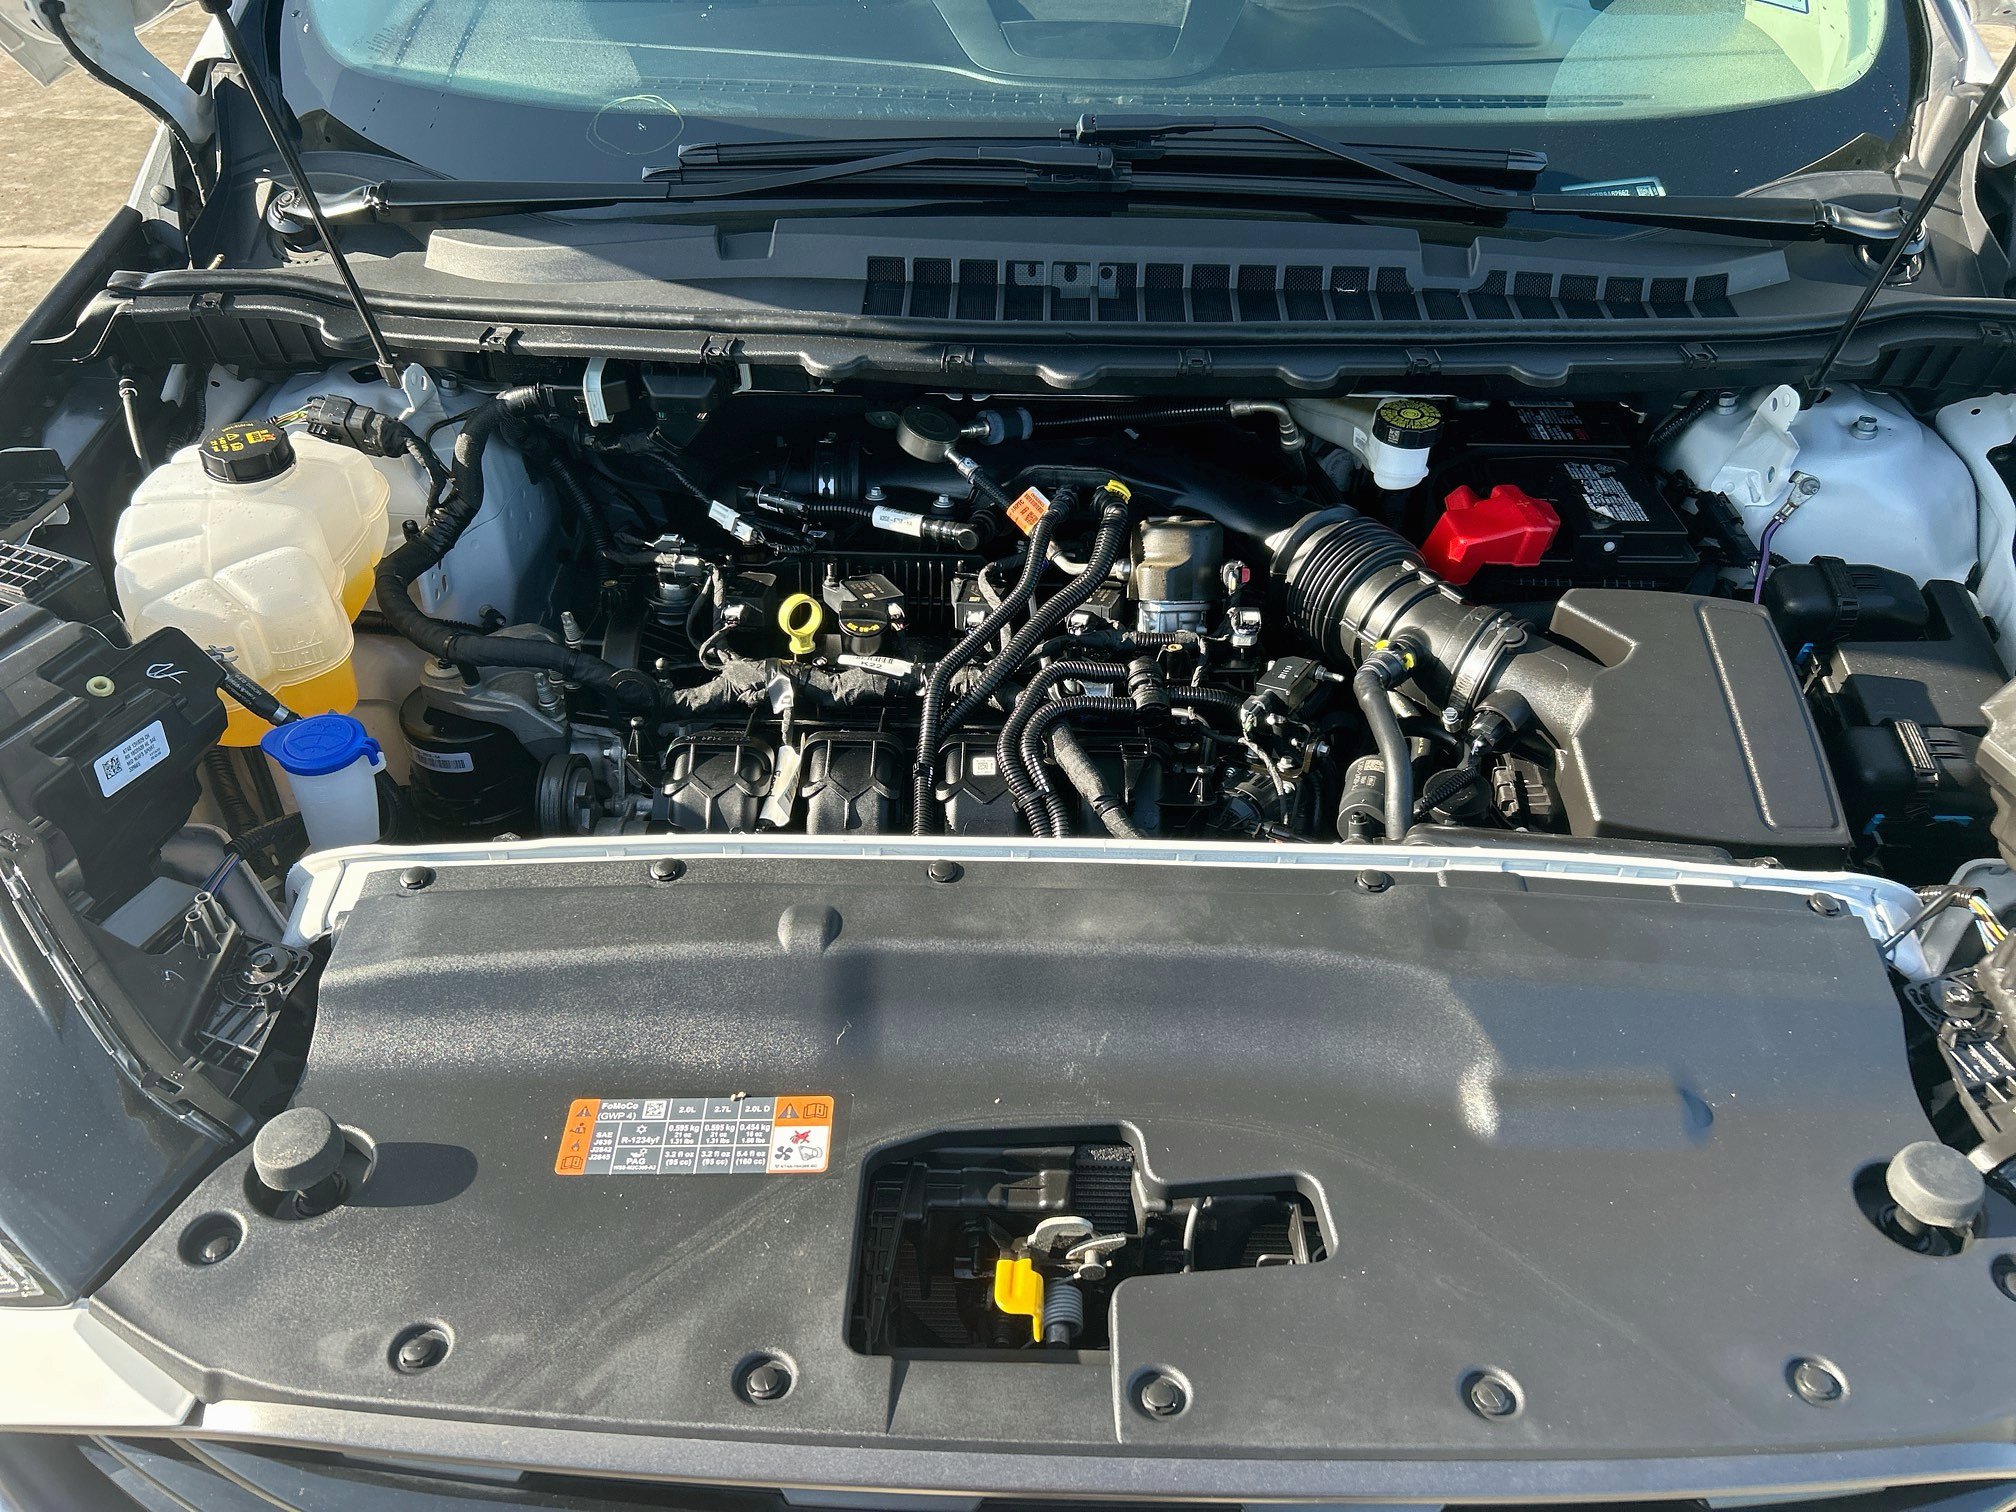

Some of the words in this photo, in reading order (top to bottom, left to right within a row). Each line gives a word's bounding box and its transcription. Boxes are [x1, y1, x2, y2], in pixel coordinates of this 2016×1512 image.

[601, 1102, 639, 1110] FoMoCo
[745, 1105, 762, 1113] 2.0L
[597, 1112, 626, 1121] (GWP
[626, 1112, 637, 1121] 4)
[690, 1124, 700, 1133] kg
[725, 1124, 736, 1133] kg
[761, 1123, 771, 1132] kg
[596, 1131, 614, 1139] SAE
[621, 1136, 661, 1145] R-1234yf
[626, 1157, 647, 1165] PAG
[679, 1158, 692, 1166] cc)
[716, 1158, 728, 1166] cc)
[753, 1157, 766, 1166] cc)
